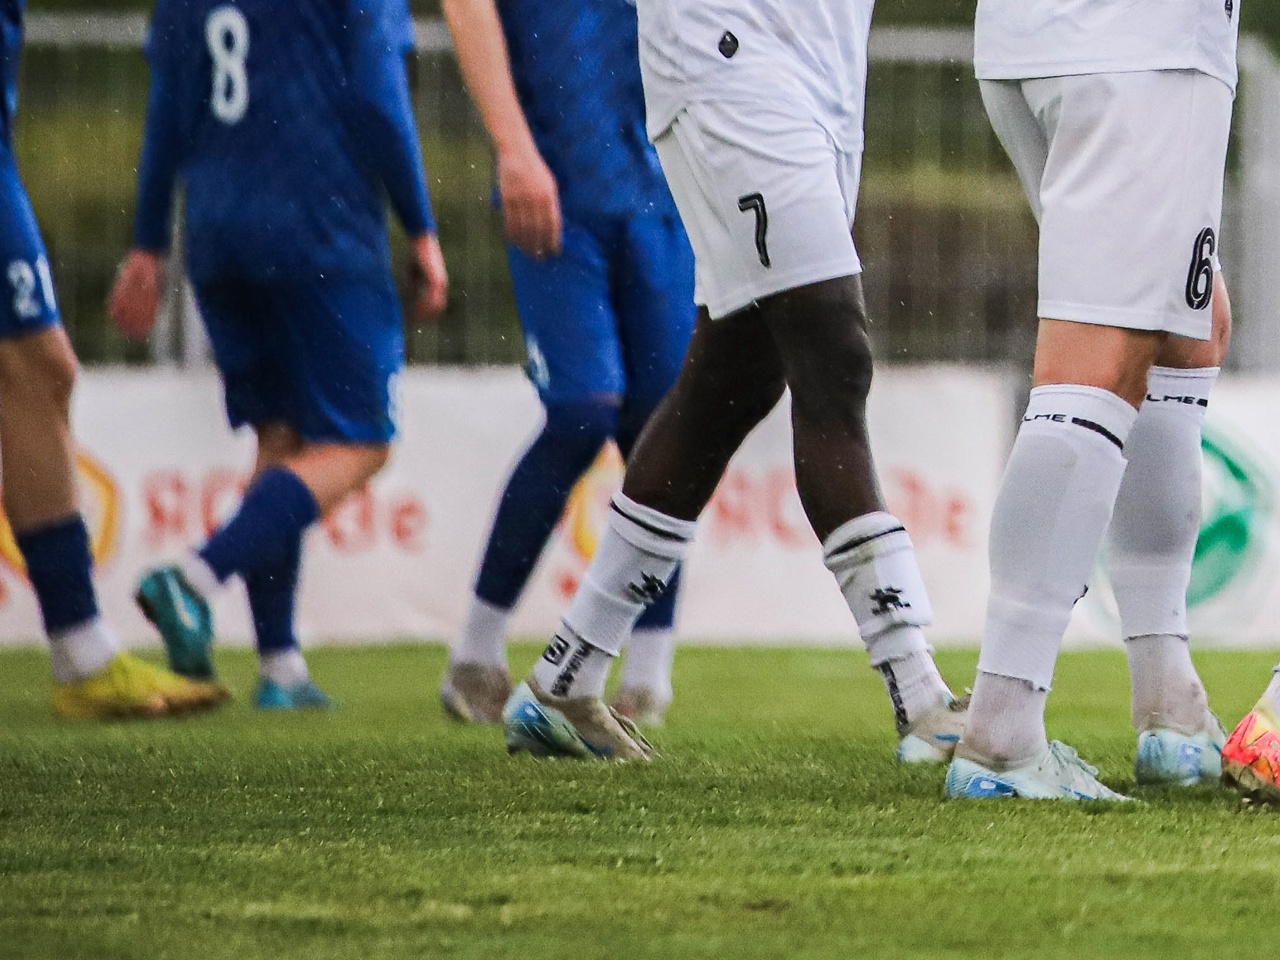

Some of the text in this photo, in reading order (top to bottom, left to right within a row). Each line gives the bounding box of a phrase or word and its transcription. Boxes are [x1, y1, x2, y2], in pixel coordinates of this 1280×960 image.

[205, 5, 250, 123] 8
[738, 193, 771, 269] 7
[1186, 227, 1214, 310] 6
[1022, 414, 1067, 423] LME
[1146, 394, 1194, 405] LME
